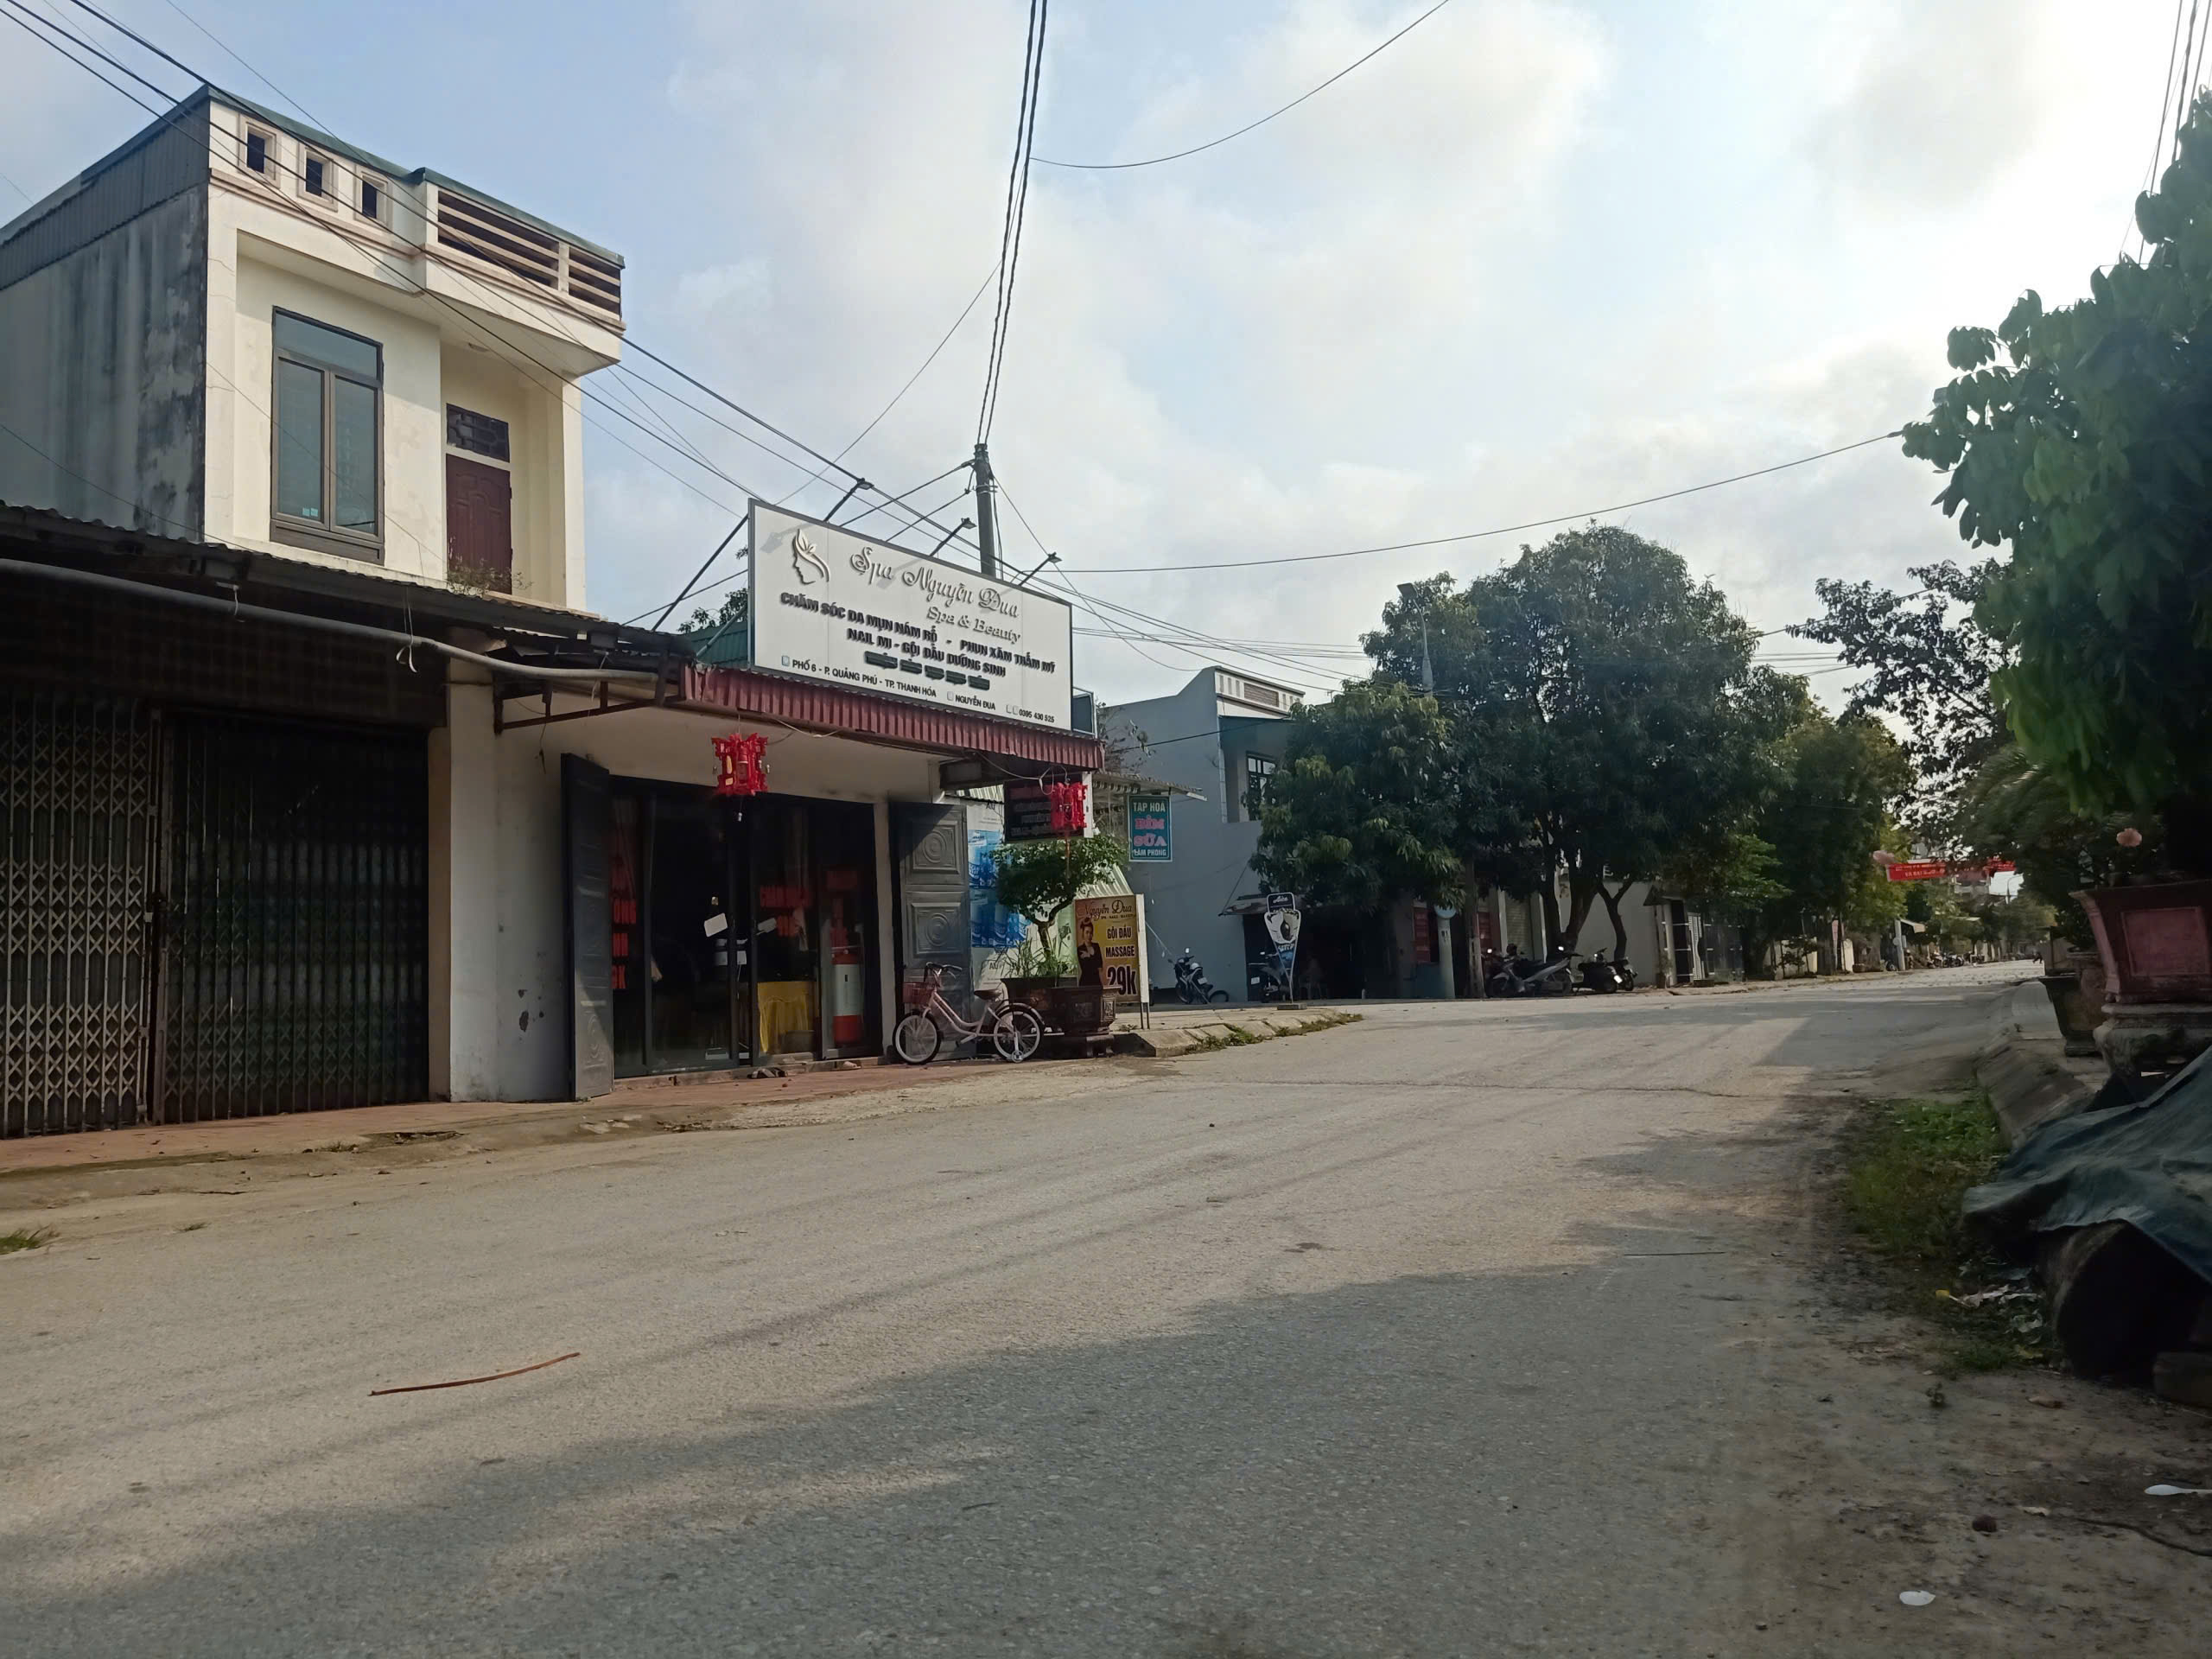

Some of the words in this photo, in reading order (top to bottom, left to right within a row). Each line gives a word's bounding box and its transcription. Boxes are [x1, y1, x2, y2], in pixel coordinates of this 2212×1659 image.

[850, 546, 893, 585] Spa
[902, 567, 973, 607] Nguyễn
[978, 588, 1020, 618] Đua
[926, 606, 954, 624] Spa
[958, 614, 970, 628] &
[973, 618, 1020, 644] Beauty
[781, 592, 819, 613] CHĂM
[821, 602, 846, 619] SÓC
[866, 614, 893, 632] MỤN
[894, 622, 921, 639] NÁM
[960, 639, 988, 656] PHUN
[989, 646, 1013, 662] XĂM
[1014, 652, 1040, 671] THẨM
[1041, 661, 1056, 674] MỸ
[847, 628, 874, 645] NAIL
[876, 635, 893, 649] MI
[901, 641, 920, 658] GỘI
[946, 653, 981, 671] DƯỠNG
[982, 662, 1006, 677] SINH
[792, 659, 810, 671] PHỐ
[811, 664, 817, 672] 6
[824, 667, 830, 676] P.
[832, 667, 861, 682] QUẢNG
[861, 674, 878, 685] PHÚ
[885, 679, 895, 689] TP.
[896, 682, 921, 695] THANH
[922, 685, 937, 697] HÓA
[982, 701, 995, 710] ĐUA
[1019, 709, 1033, 718] 0395
[1033, 712, 1044, 721] 430
[1045, 714, 1055, 723] 525
[1134, 802, 1147, 814] TẠP
[1134, 833, 1167, 847] SỮA
[1112, 899, 1132, 914] Đua
[1107, 926, 1118, 941] GỘI
[1105, 945, 1135, 958] MASSAGE
[1107, 965, 1137, 995] 29k
